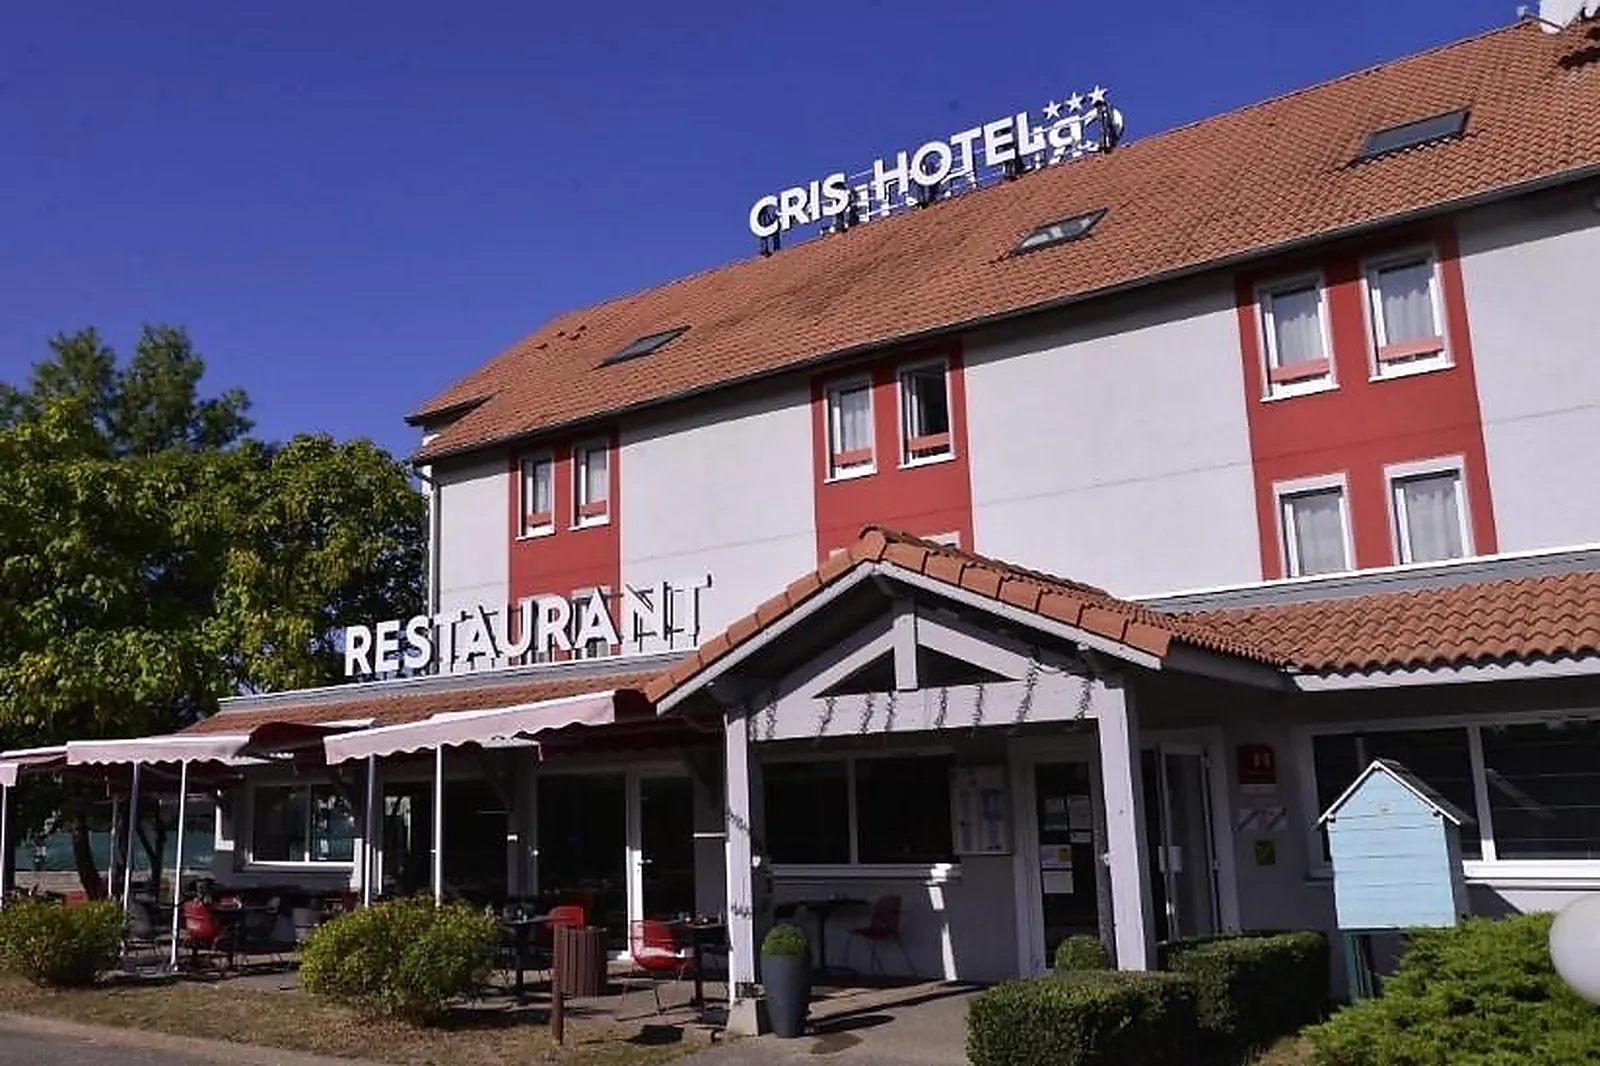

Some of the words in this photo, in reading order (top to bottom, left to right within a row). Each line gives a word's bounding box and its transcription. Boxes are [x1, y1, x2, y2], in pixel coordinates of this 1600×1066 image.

[749, 173, 850, 237] CRIS
[873, 111, 1044, 199] HOTEL
[344, 576, 711, 677] RESTAURANT
